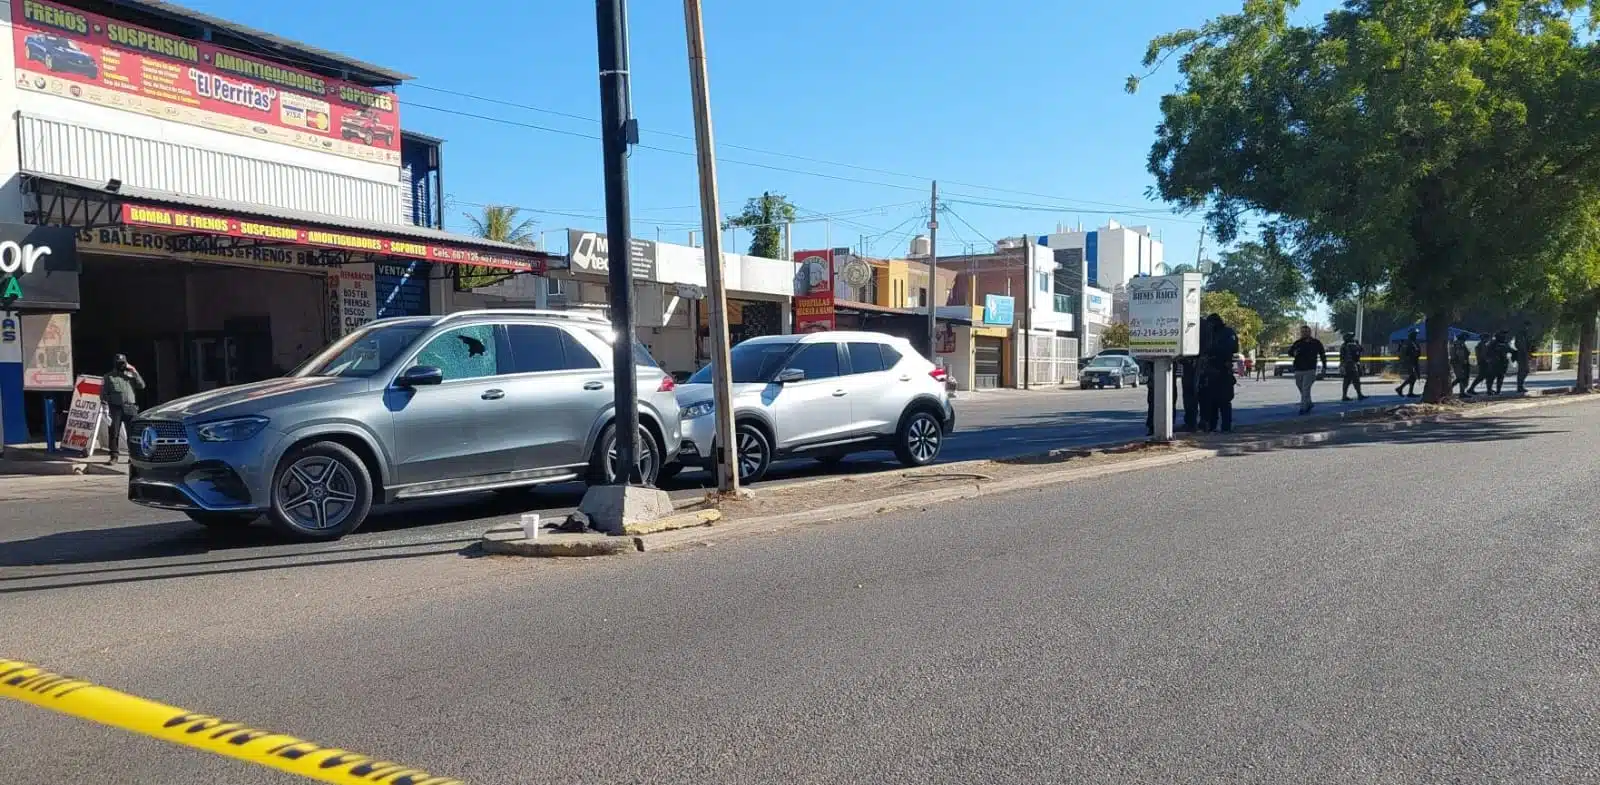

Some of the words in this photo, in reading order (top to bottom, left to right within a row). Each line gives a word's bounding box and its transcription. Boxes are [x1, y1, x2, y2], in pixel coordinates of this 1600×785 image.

[23, 3, 88, 34] FRENOS
[107, 23, 199, 62] SUSPENSIÓN
[214, 52, 326, 95] AMORTIGUADORES
[339, 85, 393, 111] SOPORTES
[130, 207, 172, 224] BOMBA
[175, 213, 189, 226] DE
[190, 215, 229, 231] FRENOS
[308, 230, 381, 250] AMORTIGUADORES
[390, 240, 427, 257] SOPORTES
[245, 246, 293, 264] FRENOS
[75, 400, 97, 410] CLUTCH
